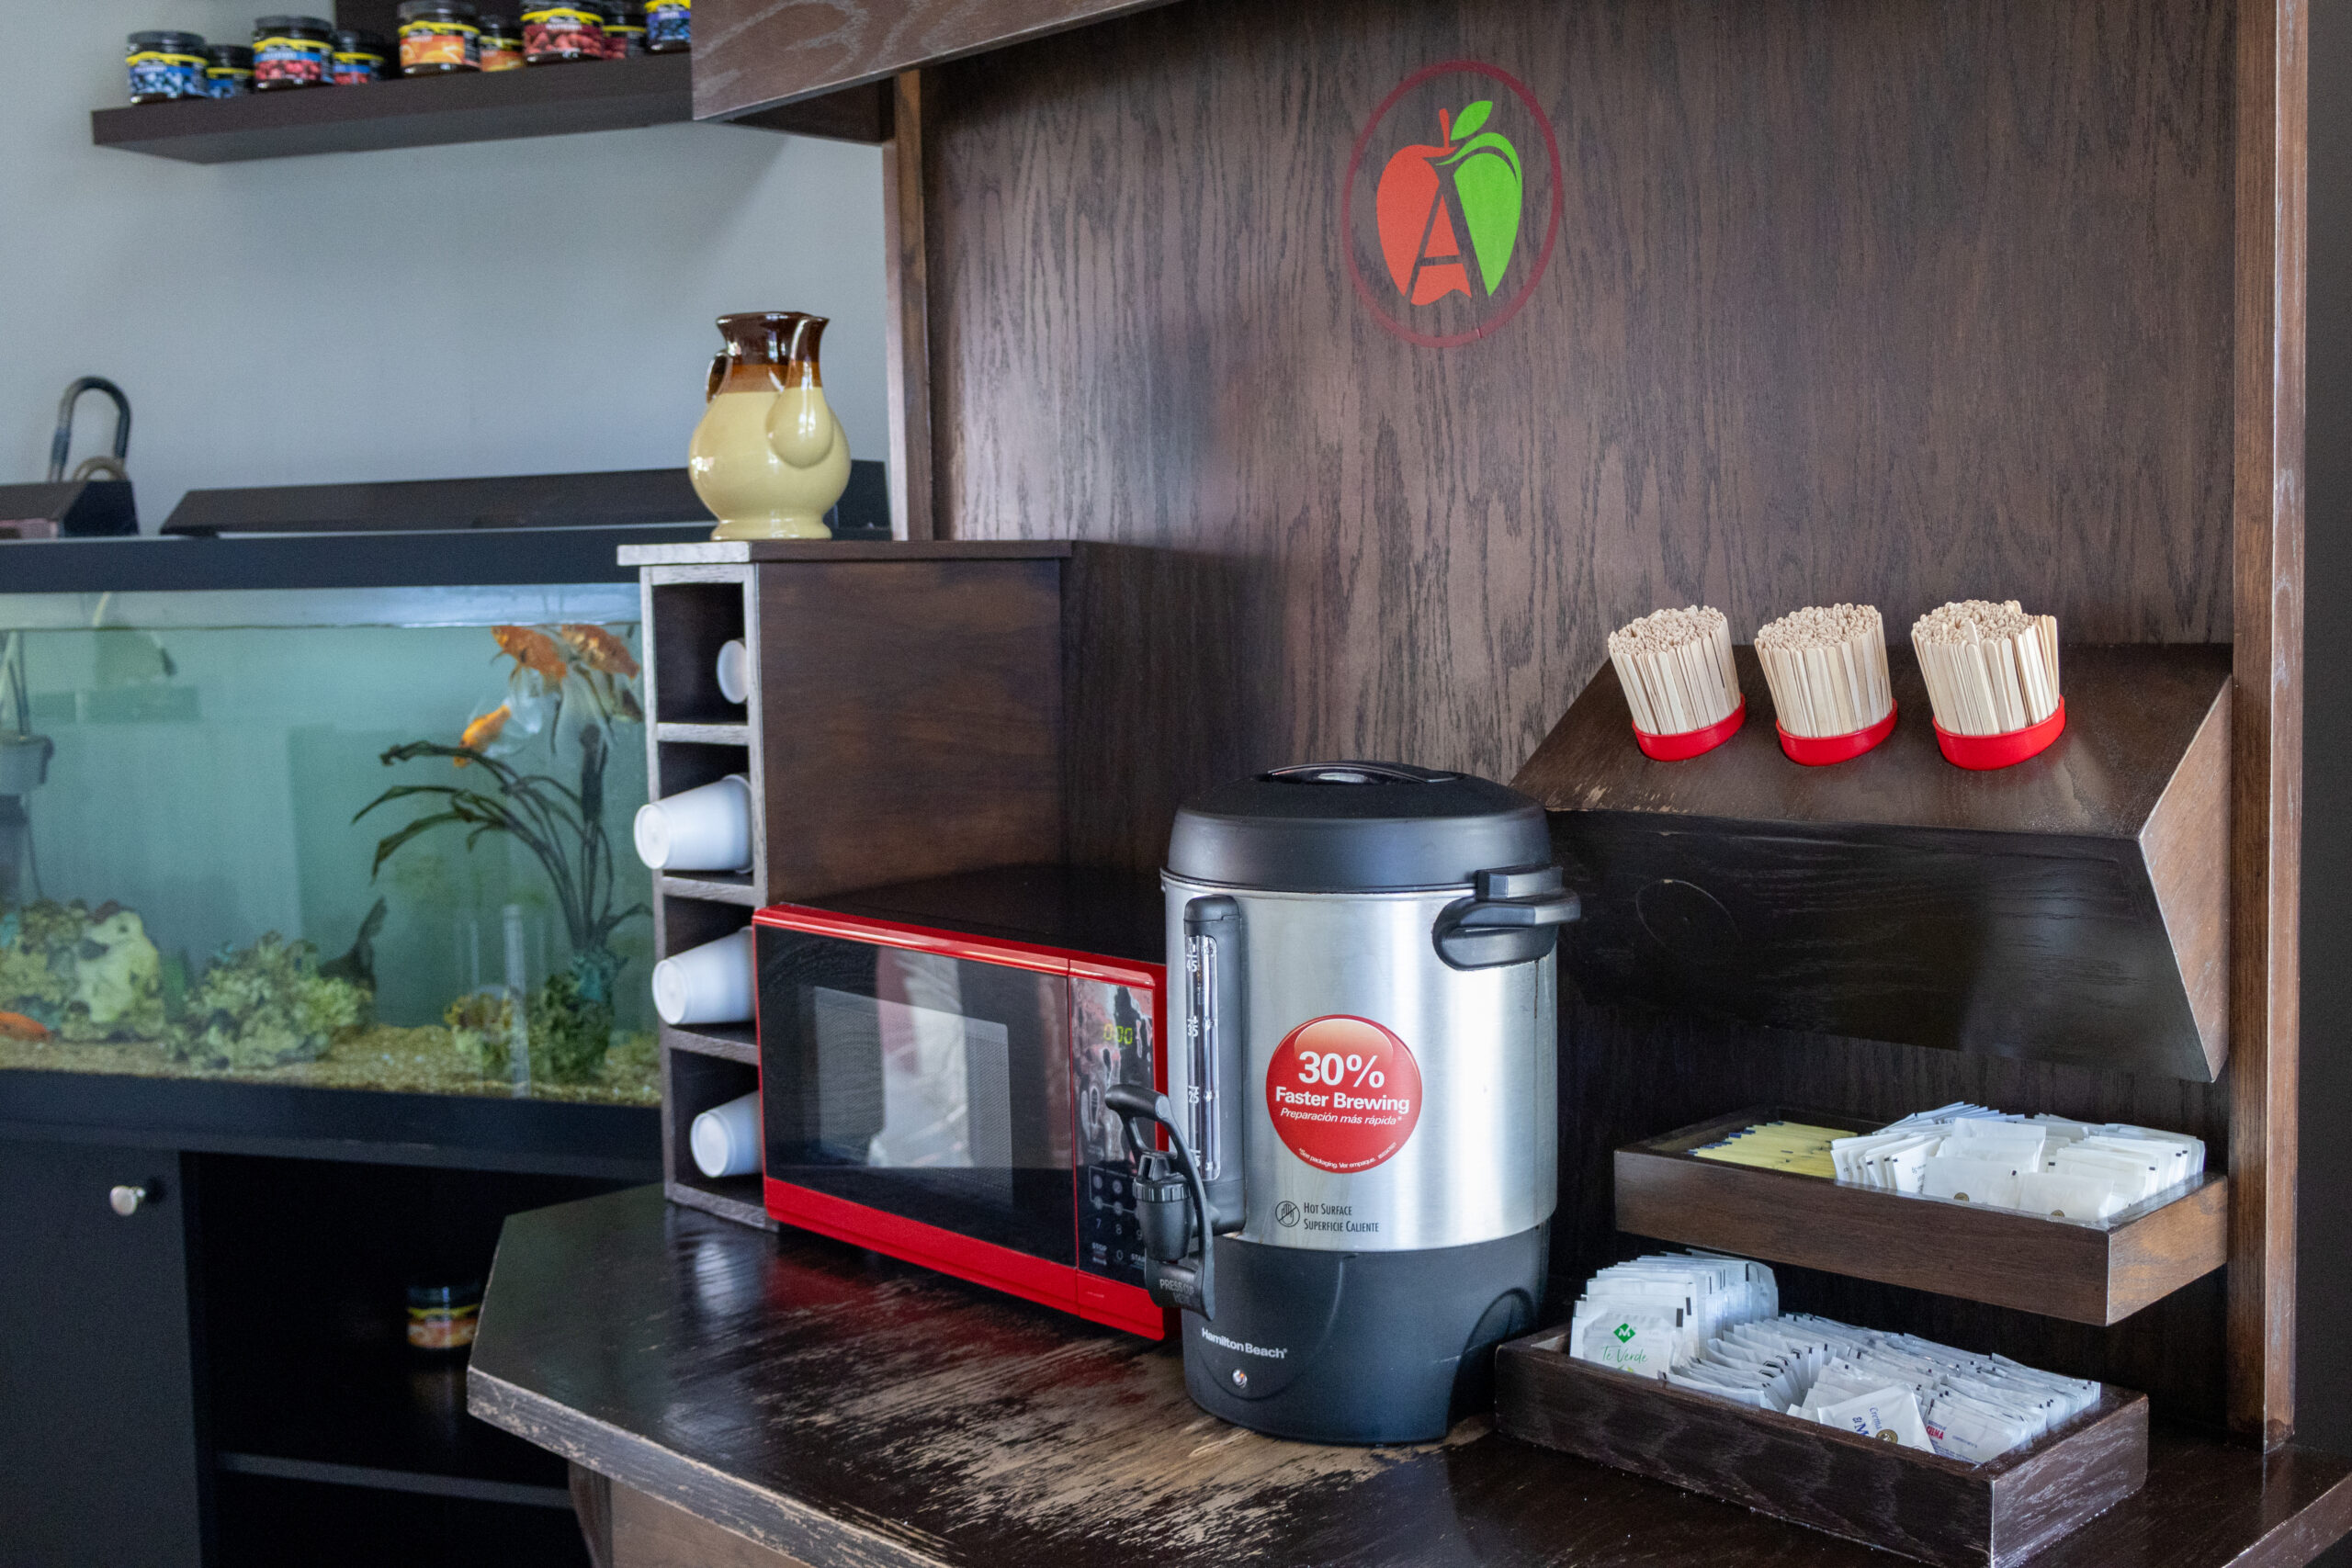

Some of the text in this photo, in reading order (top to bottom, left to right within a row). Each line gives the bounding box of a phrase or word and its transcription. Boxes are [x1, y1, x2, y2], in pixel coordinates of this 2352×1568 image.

[1298, 1050, 1385, 1089] 30%
[1275, 1086, 1409, 1114] Faster Brewing
[1280, 1107, 1338, 1122] Preparación
[1340, 1114, 1362, 1124] más
[1304, 1202, 1352, 1215] HOT SURFACE
[1304, 1218, 1379, 1232] SUPERFICIE CALIENTE
[1201, 1326, 1244, 1352] Hamilton
[1617, 1348, 1647, 1364] Verde
